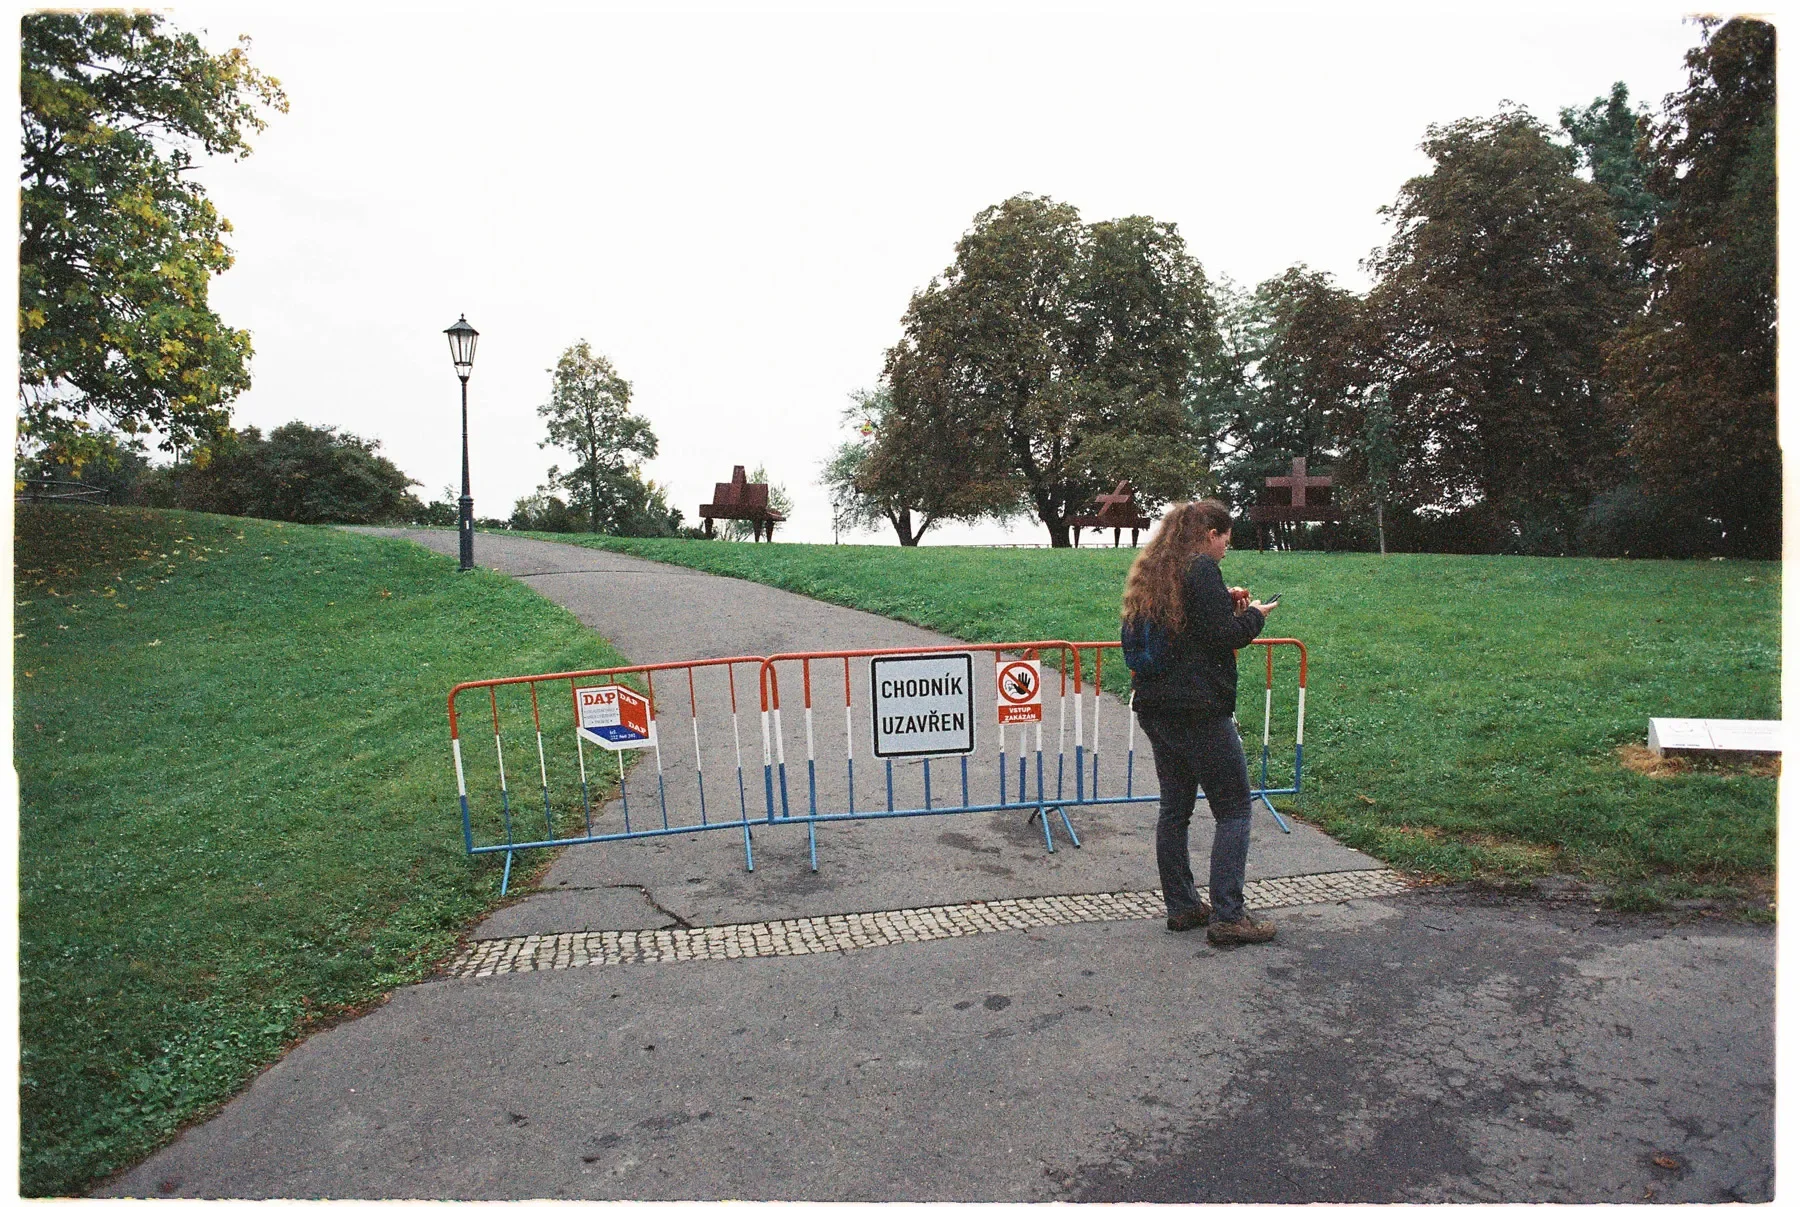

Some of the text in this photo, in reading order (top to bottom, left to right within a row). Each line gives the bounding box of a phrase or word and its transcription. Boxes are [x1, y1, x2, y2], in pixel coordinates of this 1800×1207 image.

[881, 672, 963, 698] CHODNÍK
[583, 692, 615, 705] DAP
[619, 692, 638, 705] DAP
[883, 710, 964, 734] UZAVŘEN
[1004, 713, 1036, 721] ZAKÁZÁN
[628, 720, 647, 734] DAP
